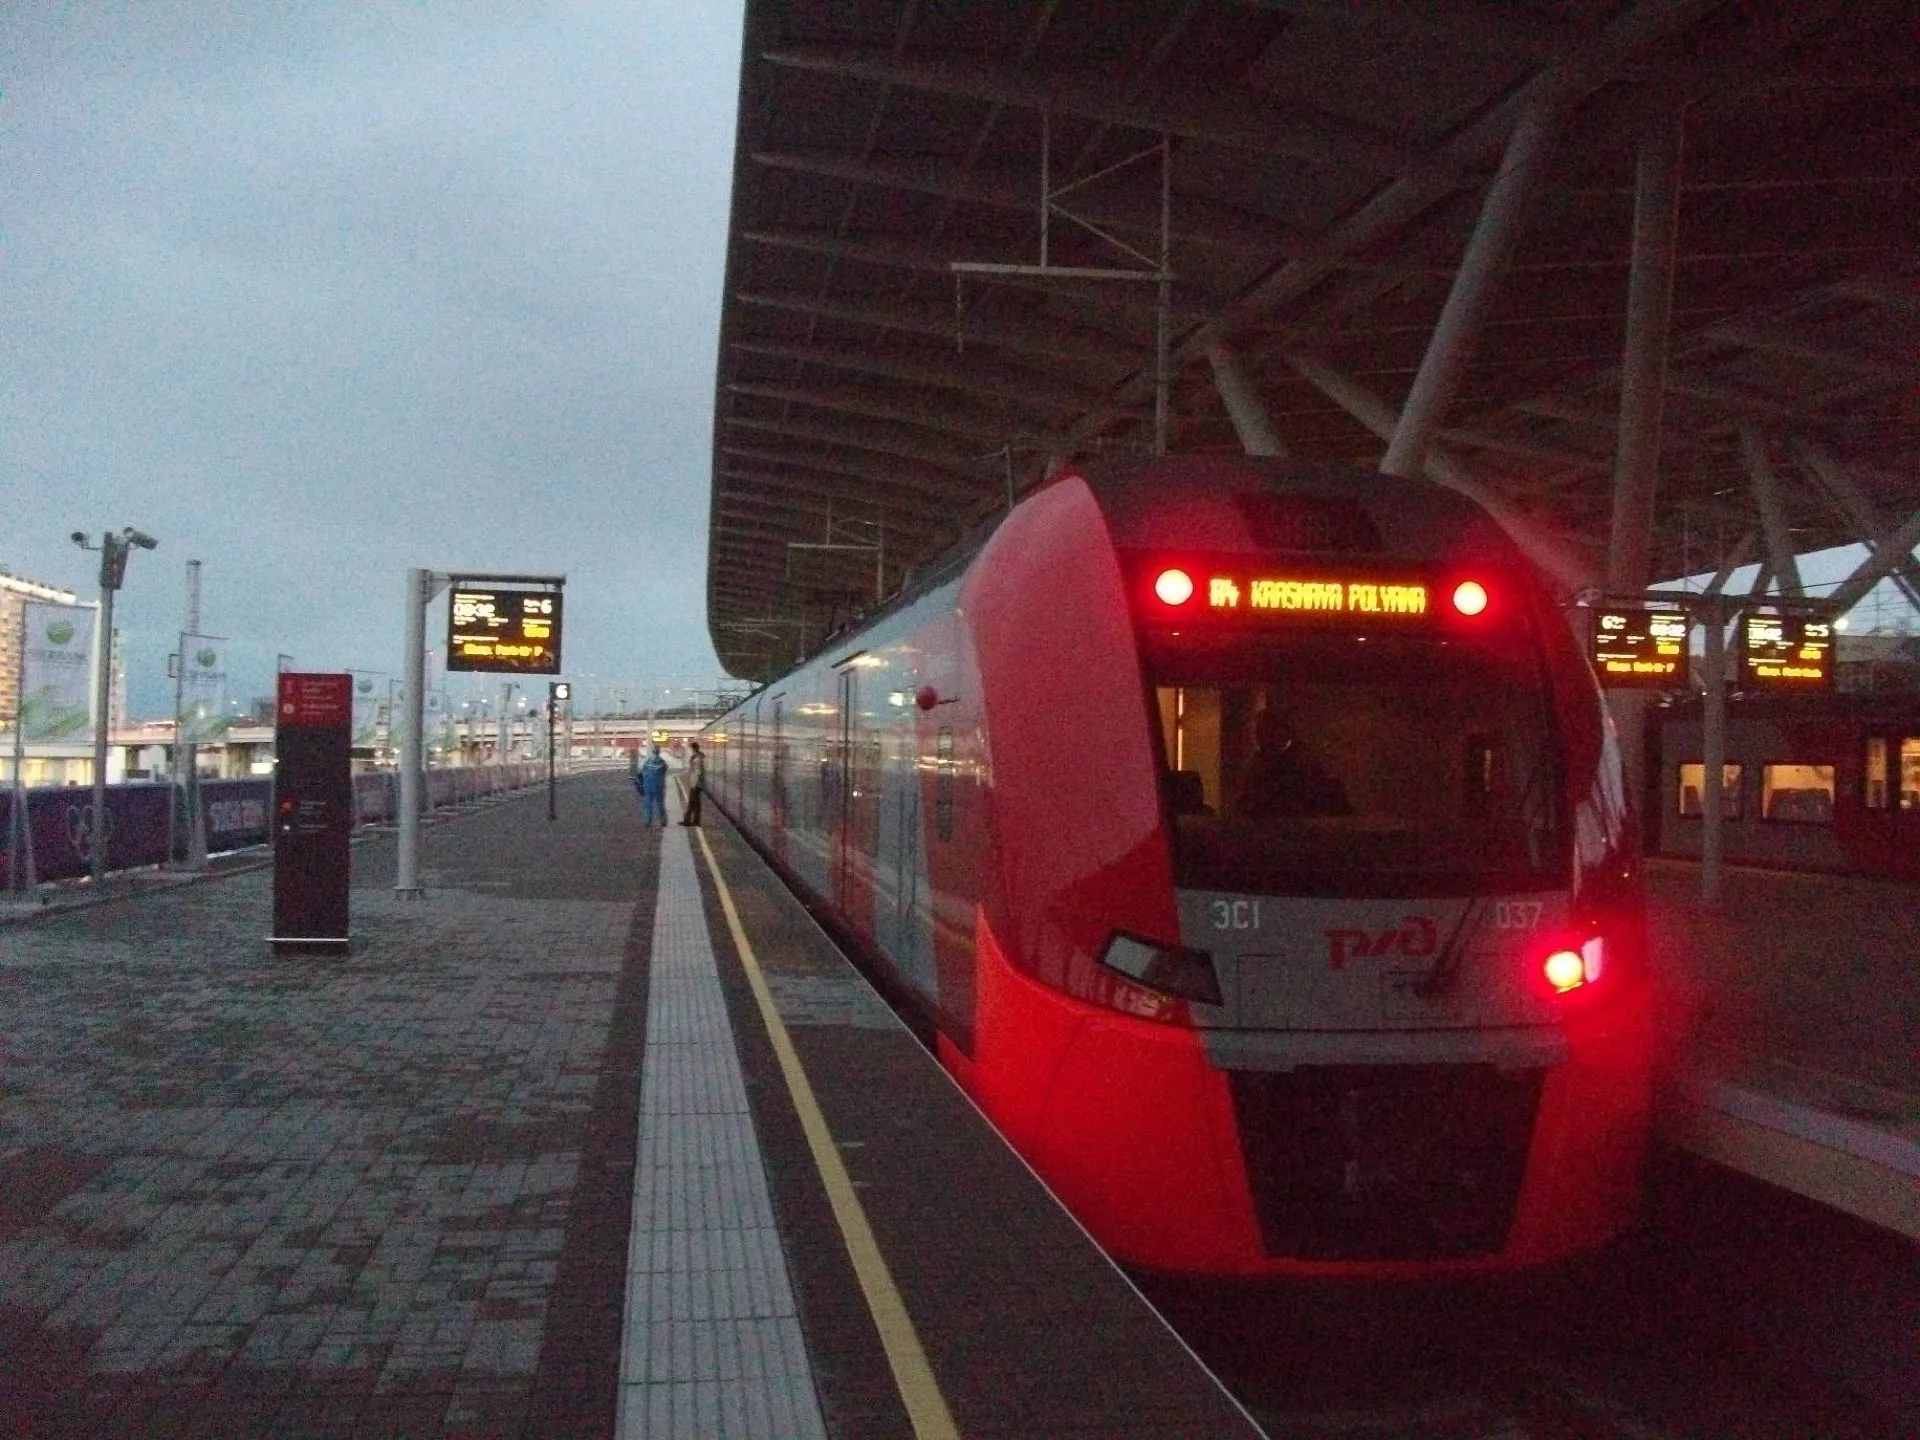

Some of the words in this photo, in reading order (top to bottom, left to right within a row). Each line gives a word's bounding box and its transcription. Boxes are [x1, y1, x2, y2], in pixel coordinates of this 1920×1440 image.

[1349, 585, 1425, 613] POLYANA
[556, 684, 568, 699] 6
[1495, 901, 1544, 929] 037
